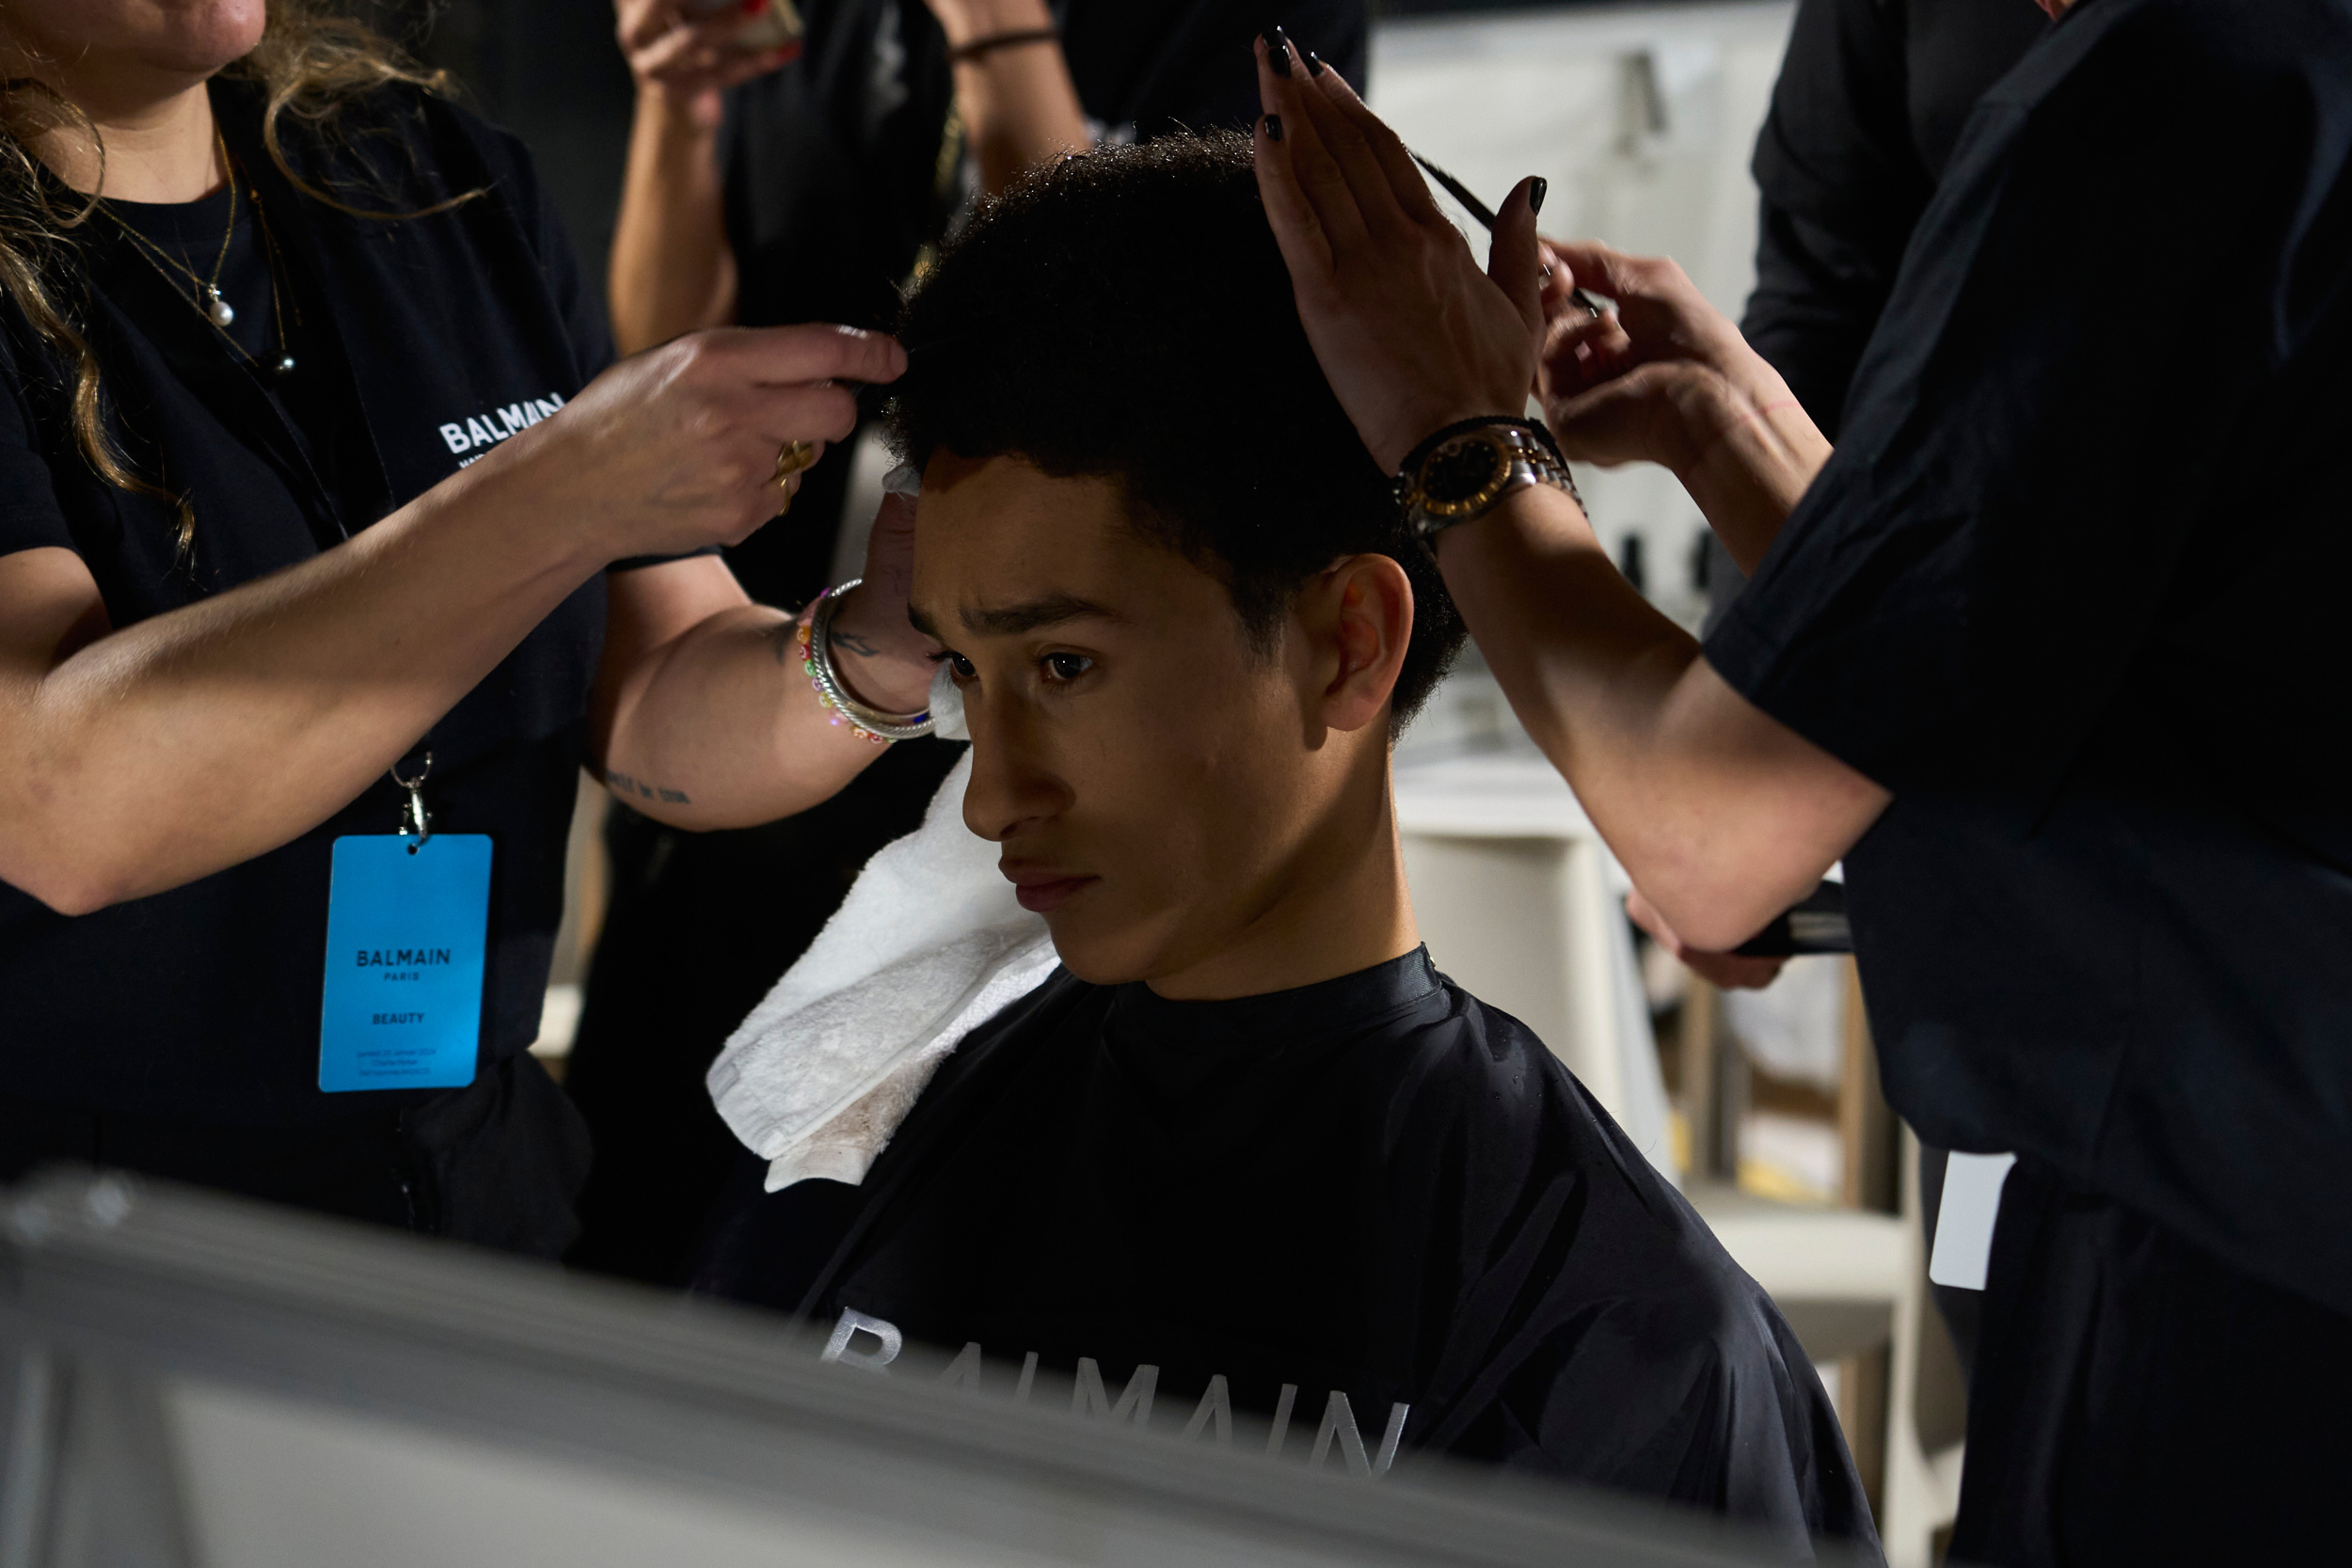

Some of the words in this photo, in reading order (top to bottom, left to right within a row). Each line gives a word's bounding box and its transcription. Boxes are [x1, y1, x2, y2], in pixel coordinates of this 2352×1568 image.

[357, 948, 451, 967] BALMAIN
[384, 972, 420, 981] PARIS
[372, 1013, 425, 1025] BEAUTY
